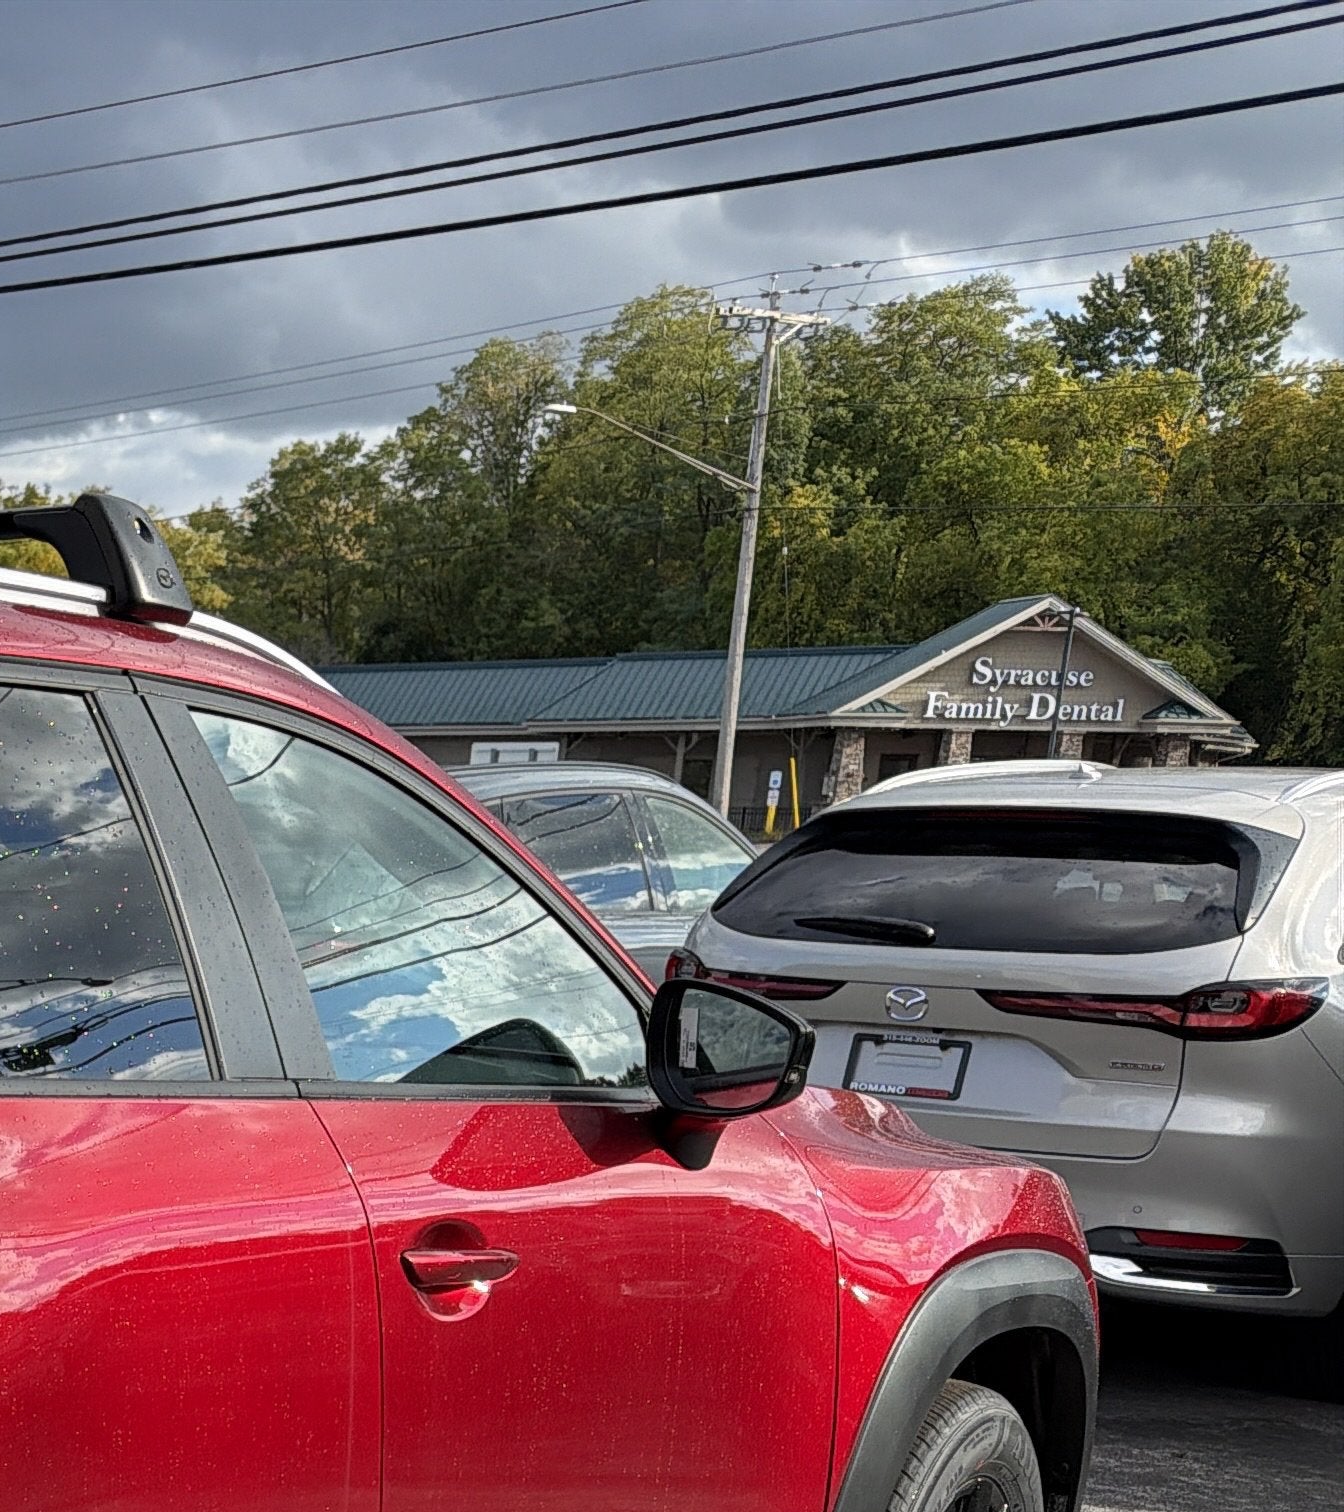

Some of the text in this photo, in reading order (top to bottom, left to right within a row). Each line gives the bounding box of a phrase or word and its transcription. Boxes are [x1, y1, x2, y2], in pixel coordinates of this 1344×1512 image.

[972, 656, 1094, 692] Syracuse
[923, 691, 1124, 727] Family Dental
[849, 1082, 906, 1095] ROMANO
